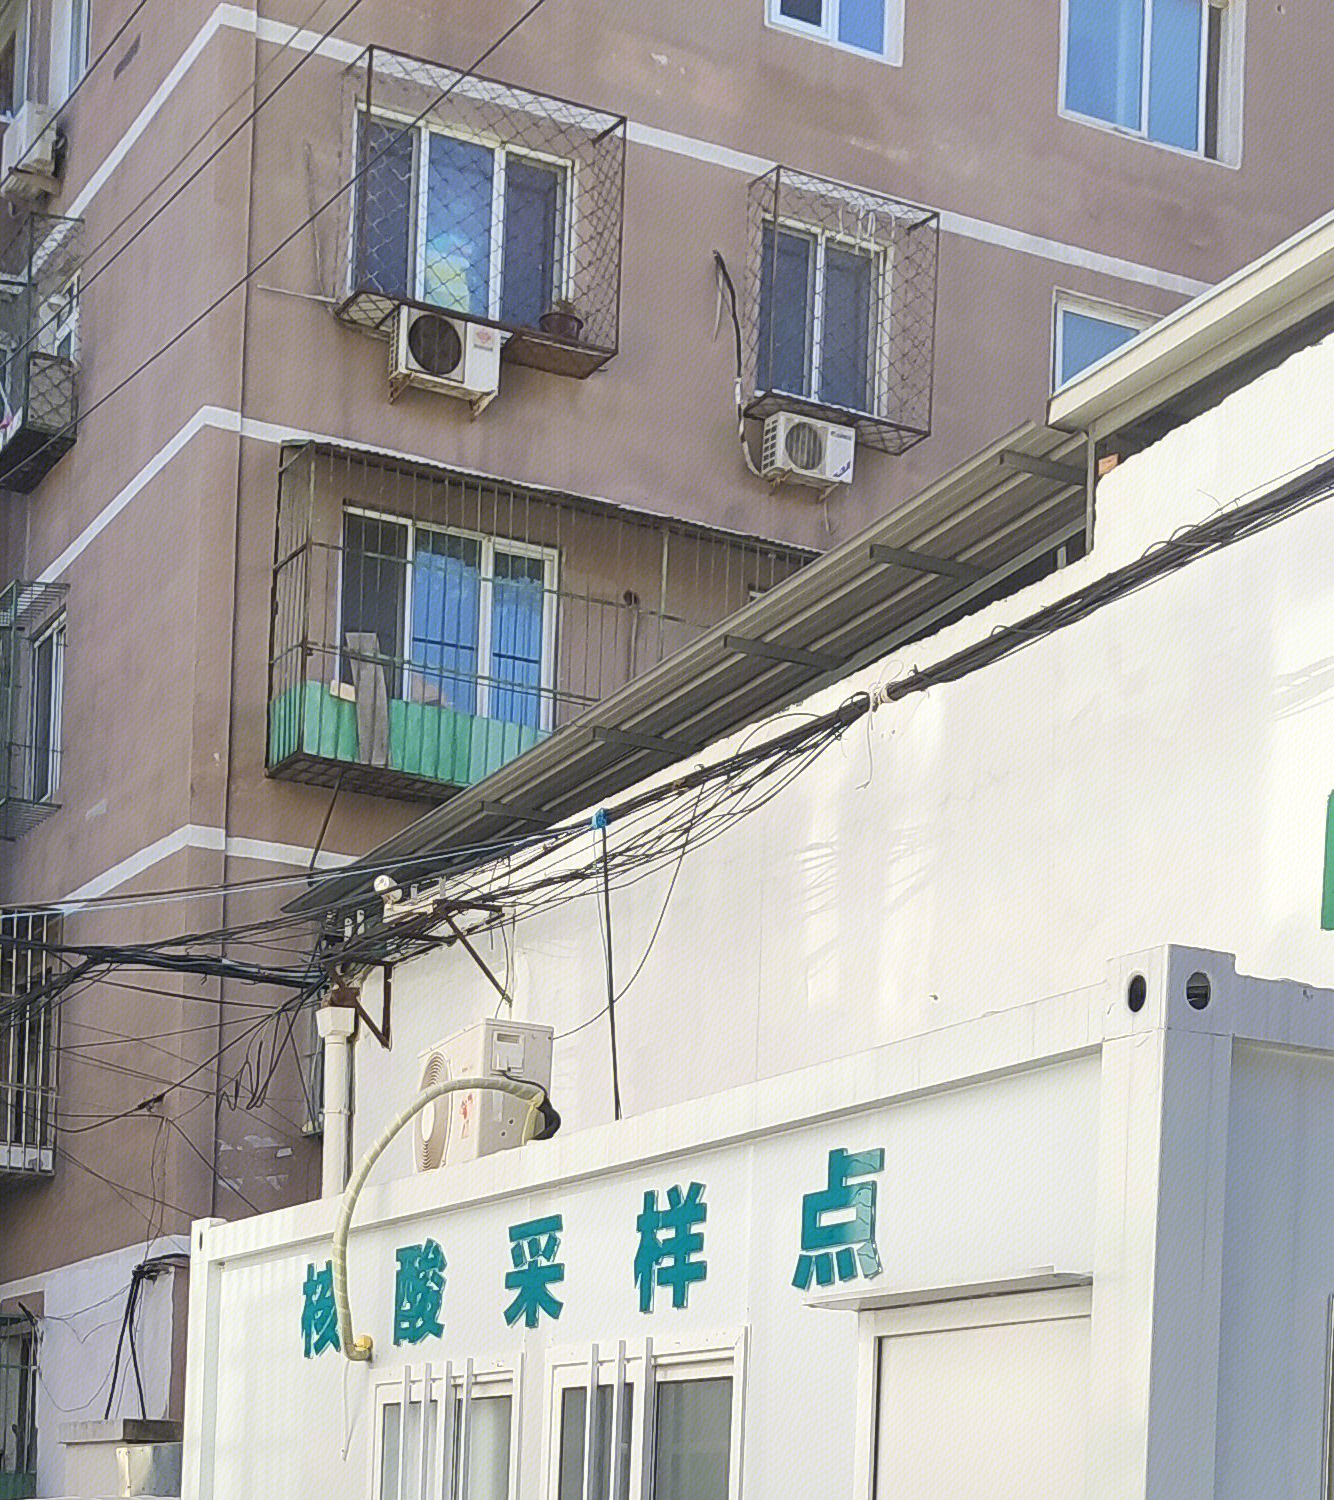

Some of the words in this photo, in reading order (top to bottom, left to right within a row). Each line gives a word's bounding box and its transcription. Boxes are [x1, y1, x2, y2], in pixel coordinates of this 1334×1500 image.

[301, 1147, 885, 1358] 核酸采样点
